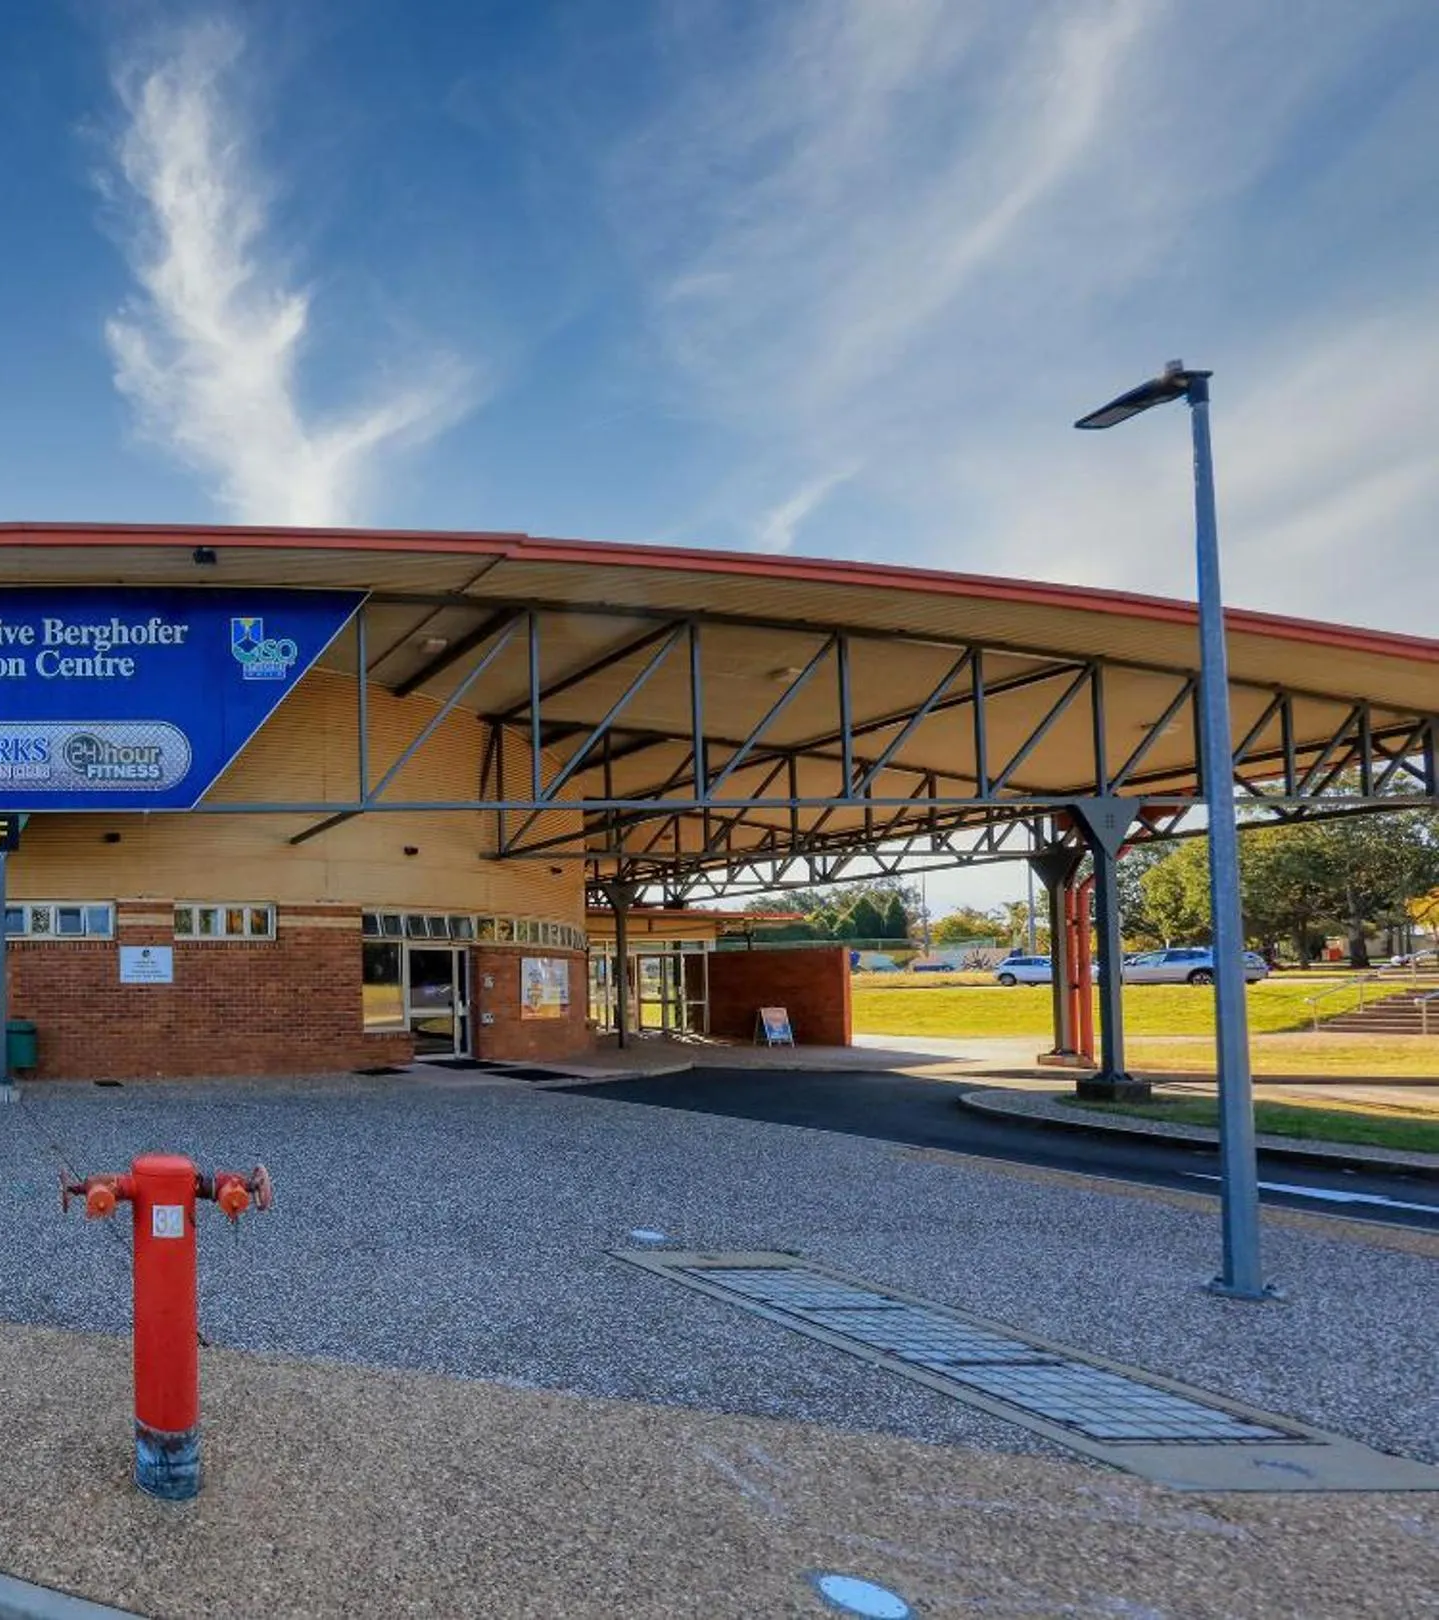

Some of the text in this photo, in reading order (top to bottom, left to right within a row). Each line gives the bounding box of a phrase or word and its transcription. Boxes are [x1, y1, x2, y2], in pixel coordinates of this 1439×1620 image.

[42, 617, 189, 652] Berghofer
[35, 650, 136, 678] Centre
[87, 764, 161, 779] FITNESS
